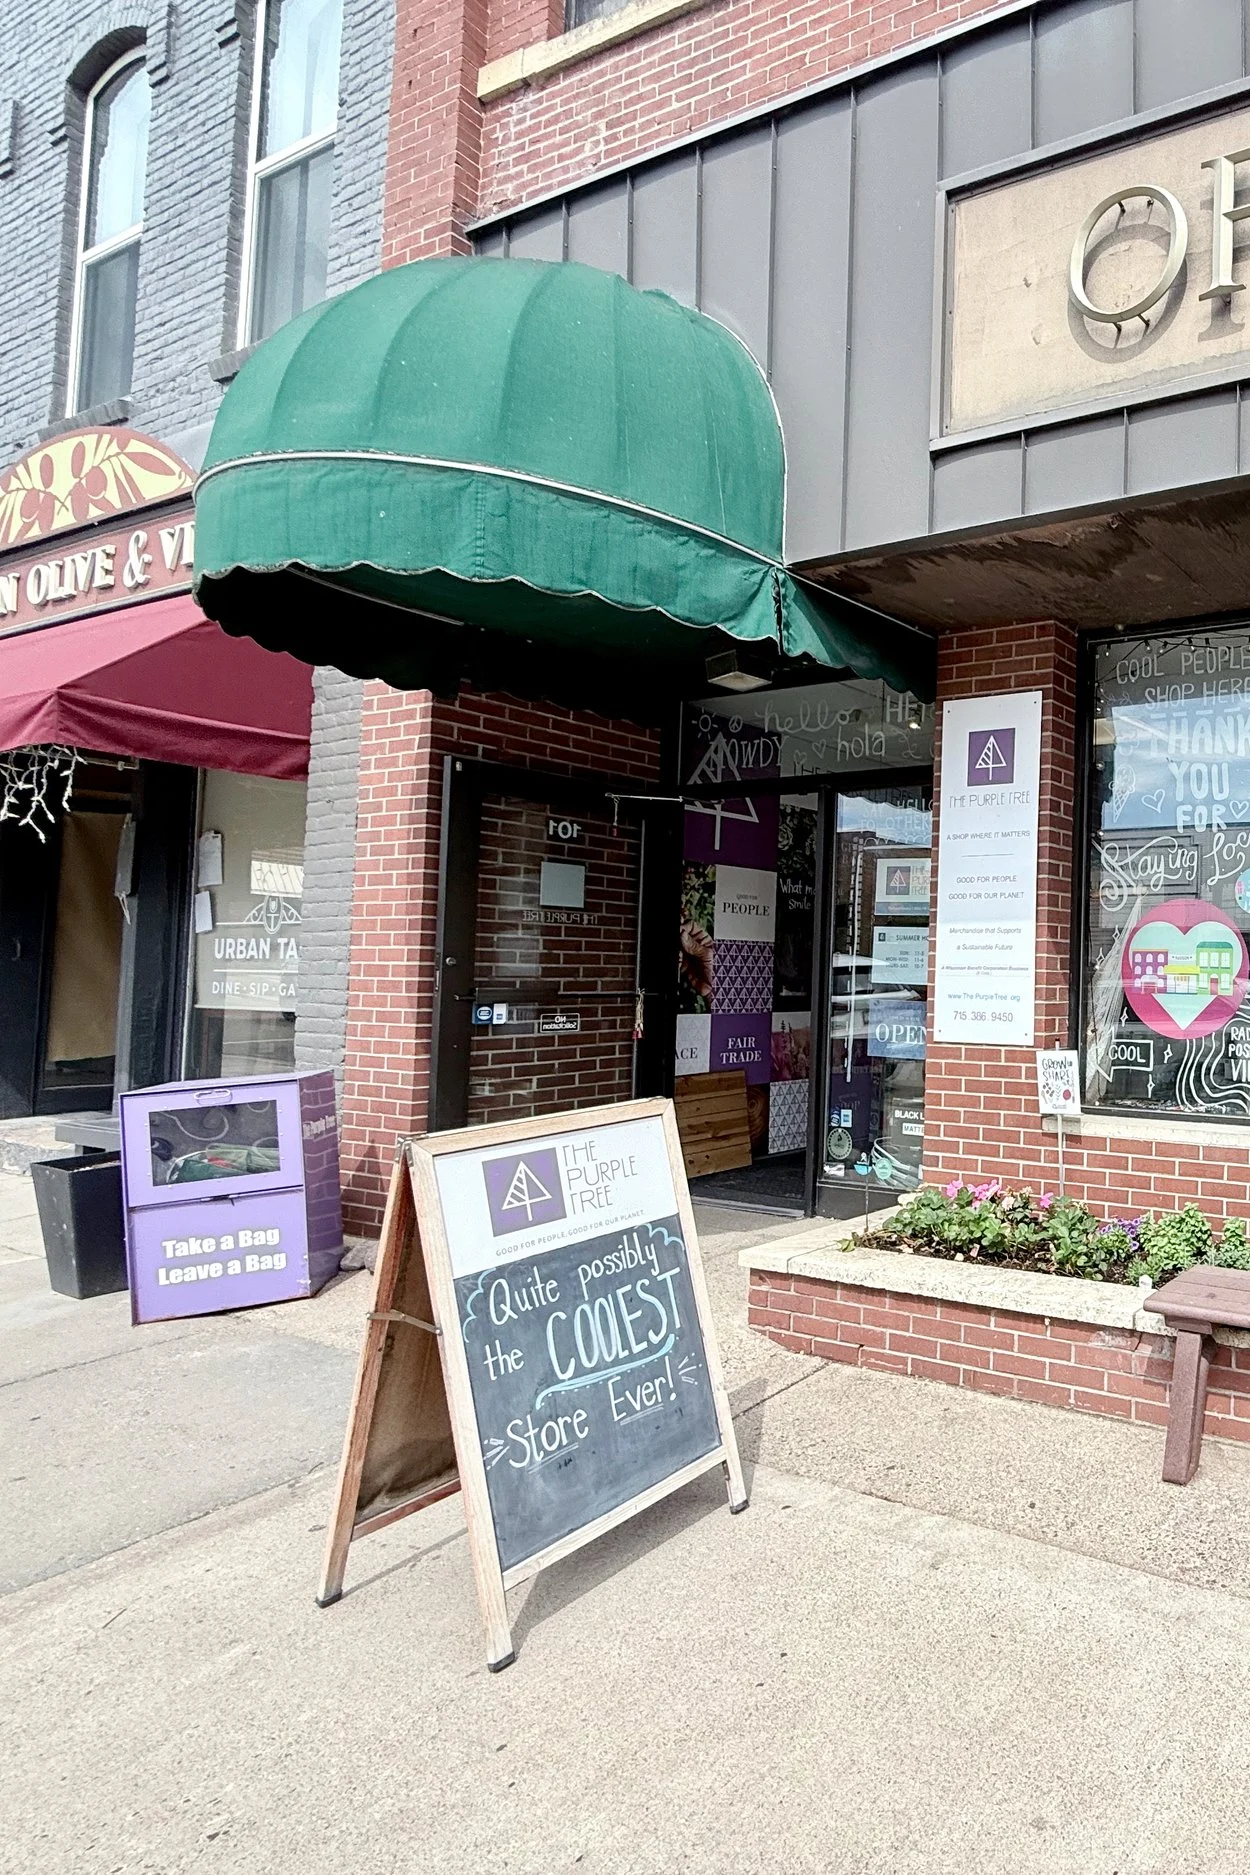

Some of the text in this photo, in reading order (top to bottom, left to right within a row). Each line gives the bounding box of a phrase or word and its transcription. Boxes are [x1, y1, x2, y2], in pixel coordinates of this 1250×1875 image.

[26, 544, 117, 605] OLIVE
[122, 529, 153, 588] &
[1115, 653, 1165, 685] COOL
[1144, 683, 1194, 710] SHOP
[754, 698, 860, 733] hello
[837, 722, 886, 761] hola
[1168, 760, 1230, 802] YOU
[949, 790, 1030, 808] THE PURPLE TREE
[1176, 804, 1228, 833] FOR
[1001, 830, 1030, 838] MATTERS
[780, 878, 802, 894] What
[956, 876, 975, 884] GOOD
[992, 875, 1017, 883] PEOPLE
[1091, 836, 1198, 912] Staying
[722, 902, 770, 916] PEOPLE
[788, 898, 811, 910] smile
[213, 937, 299, 960] URBAN TA
[212, 981, 240, 995] DINE
[250, 982, 269, 996] SIP
[720, 1050, 762, 1064] TRADE
[728, 1037, 755, 1050] FAIR
[1109, 1044, 1146, 1063] COOL
[1042, 1056, 1067, 1070] GROW
[894, 1109, 919, 1120] BLACK
[561, 1140, 598, 1167] THE
[566, 1155, 638, 1191] PURPLE
[569, 1185, 614, 1216] TREE
[162, 1228, 280, 1259] Take a Bag
[496, 1244, 519, 1257] GOOD
[520, 1237, 536, 1249] FOR
[567, 1225, 588, 1236] GOOD
[589, 1220, 604, 1230] FOR
[604, 1216, 619, 1226] OUR
[158, 1252, 287, 1286] Leave a Bag
[489, 1231, 660, 1325] Quite possibly
[484, 1267, 681, 1381] the COOLEST
[506, 1355, 676, 1468] Store Ever!
